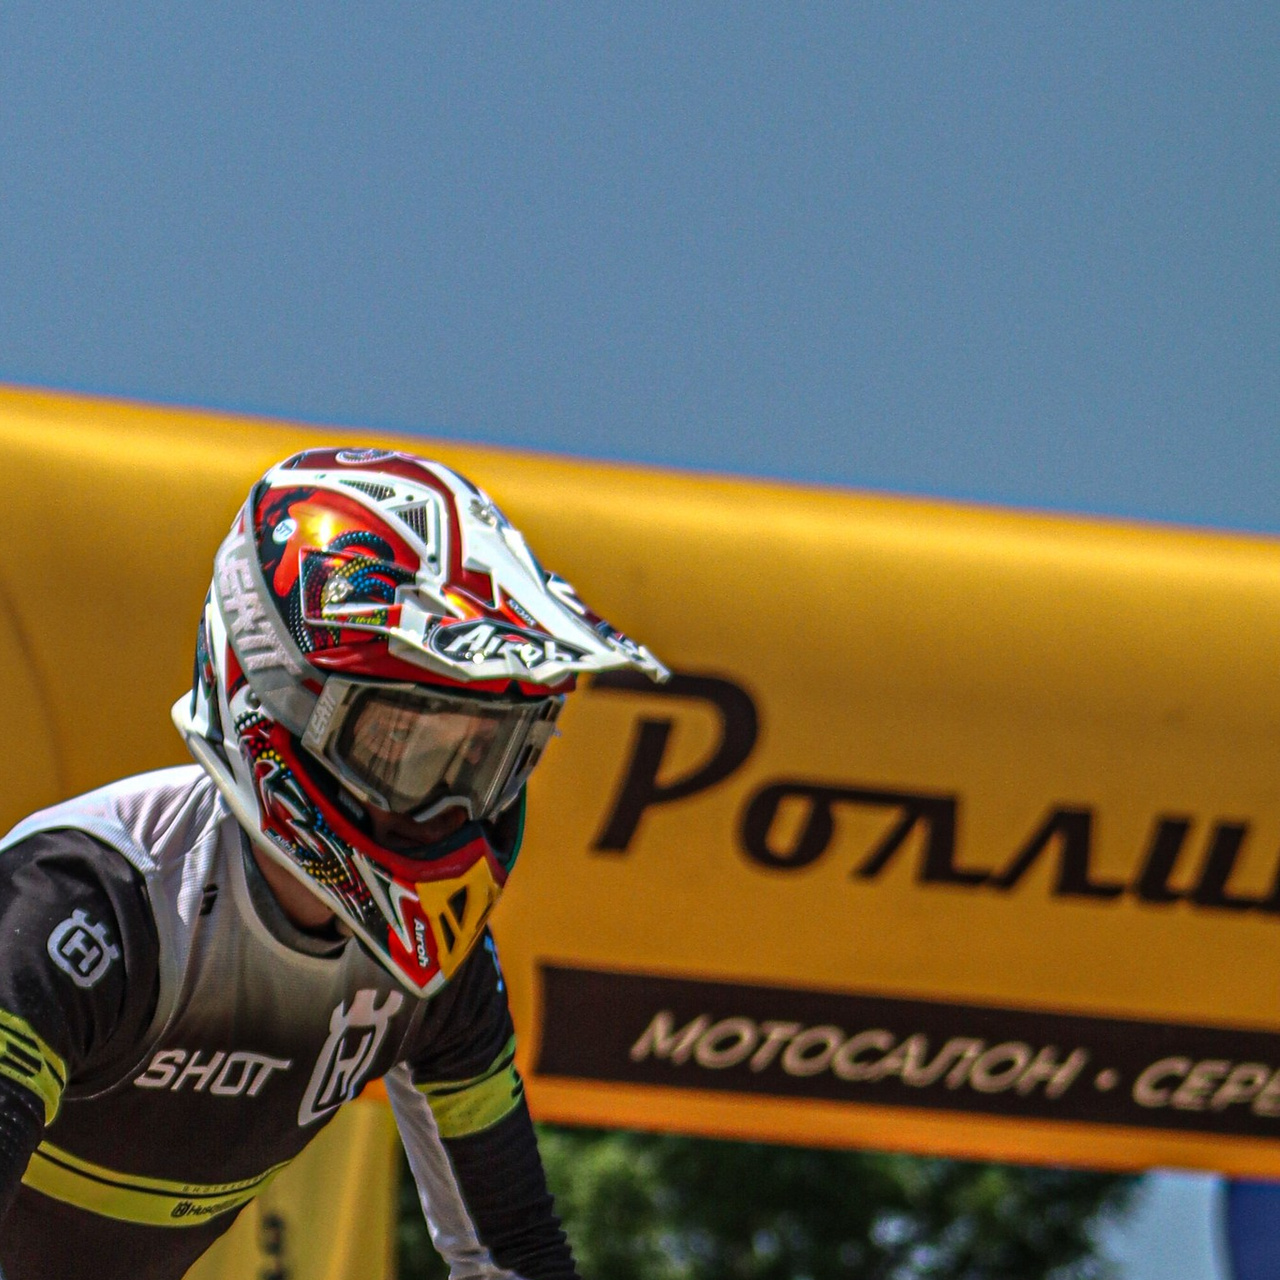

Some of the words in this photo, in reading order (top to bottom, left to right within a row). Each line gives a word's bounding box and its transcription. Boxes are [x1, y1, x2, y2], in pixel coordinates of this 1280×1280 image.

[588, 667, 1280, 922] Ролли
[413, 918, 429, 968] Airoh
[133, 1048, 293, 1097] SHOT
[631, 1011, 1090, 1098] МОТОСАЛОН
